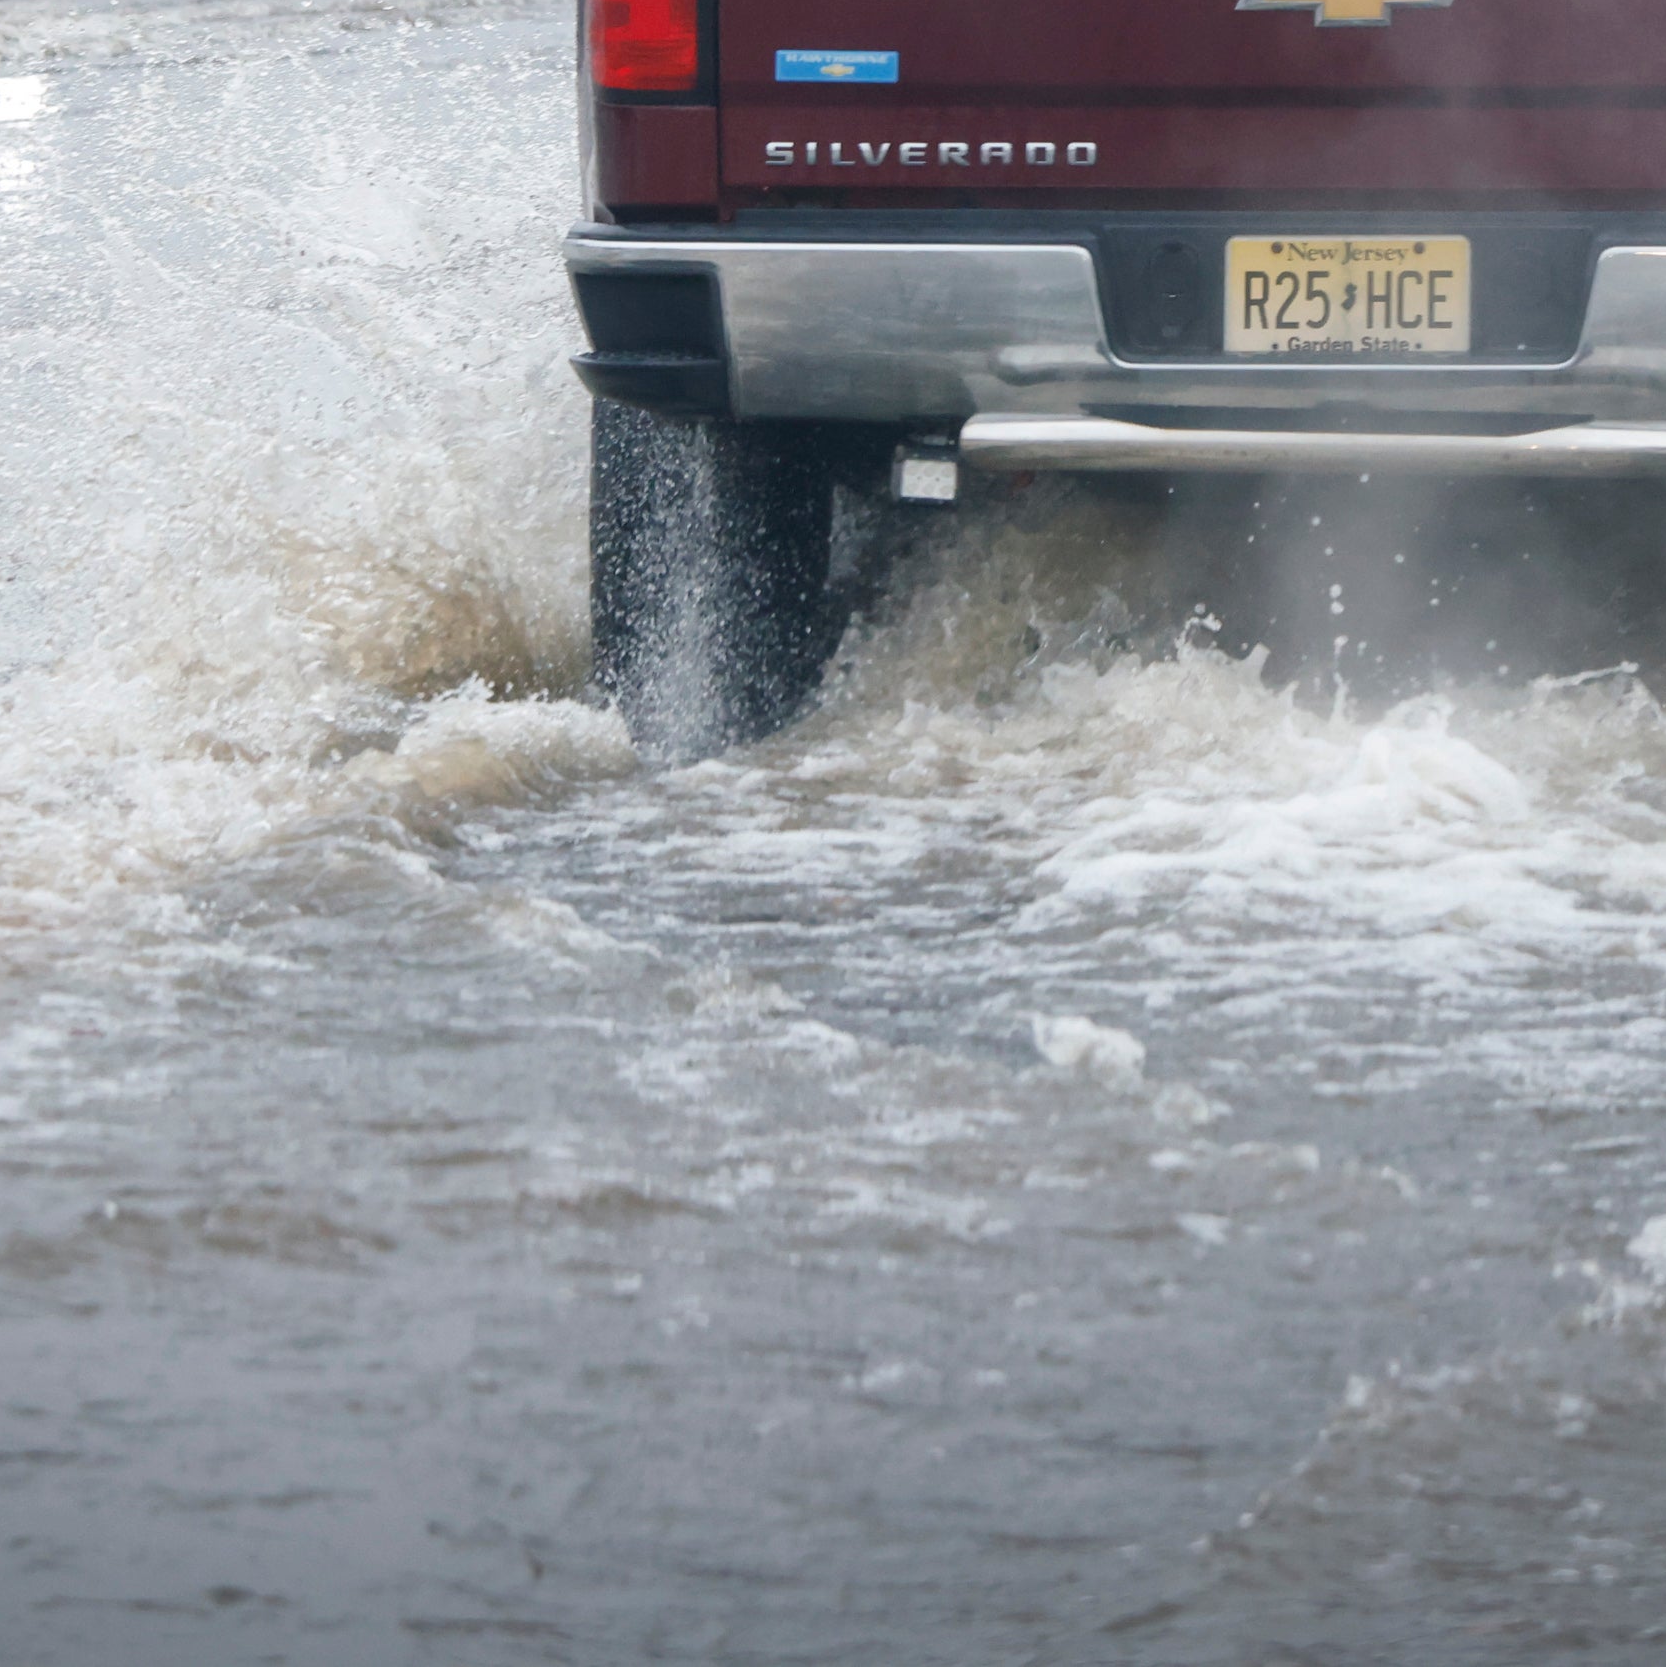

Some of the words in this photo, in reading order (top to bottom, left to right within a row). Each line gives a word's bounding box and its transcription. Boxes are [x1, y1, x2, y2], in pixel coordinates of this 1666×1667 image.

[764, 141, 1099, 167] SILVERADO
[1287, 242, 1337, 262] New
[1341, 241, 1408, 265] Jersey
[1244, 270, 1331, 330] R25
[1366, 269, 1454, 330] HCE
[1287, 336, 1355, 352] Garden
[1360, 336, 1410, 352] State
